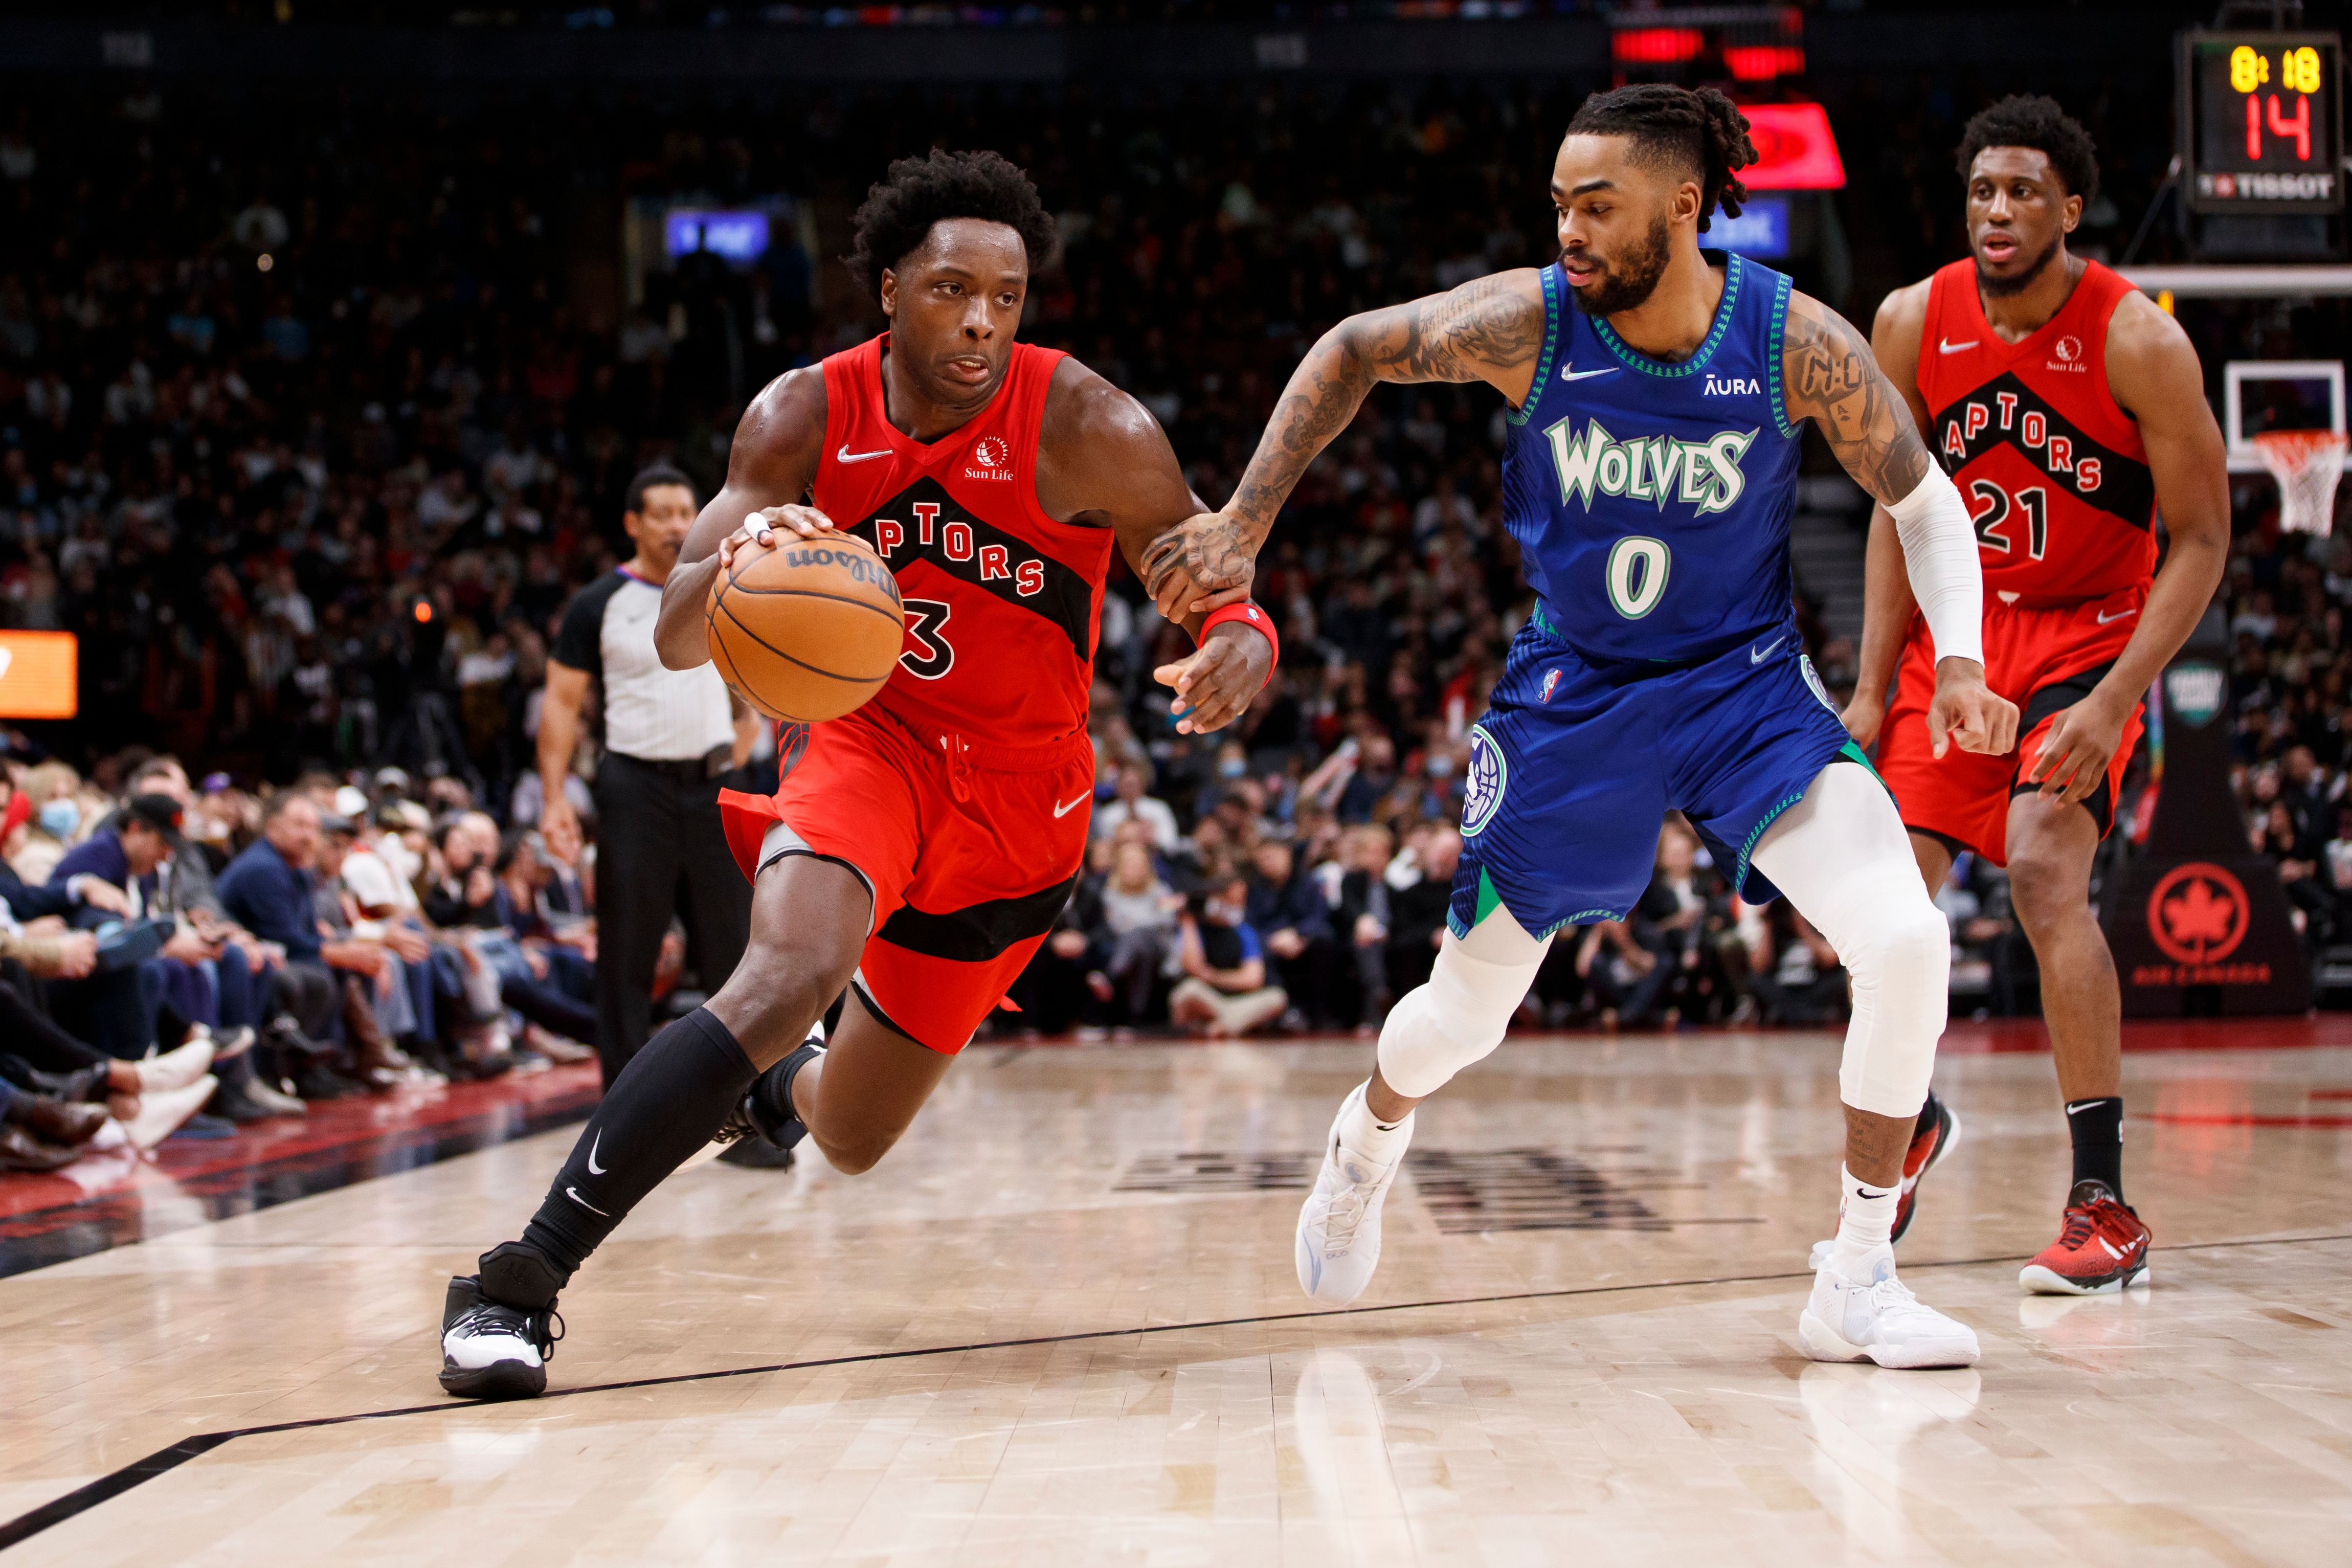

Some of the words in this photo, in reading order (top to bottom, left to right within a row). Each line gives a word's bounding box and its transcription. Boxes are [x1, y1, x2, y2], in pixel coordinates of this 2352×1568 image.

[2230, 46, 2320, 94] 8:18
[2246, 94, 2311, 161] 14
[2047, 360, 2067, 371] Sun
[2069, 362, 2087, 372] Life
[965, 467, 989, 479] Sun
[992, 469, 1013, 481] Life
[1945, 391, 2101, 492] APTORS
[875, 502, 1044, 597] PTORS
[1970, 478, 2047, 562] 21
[1606, 535, 1671, 620] 0
[898, 598, 955, 680] 3
